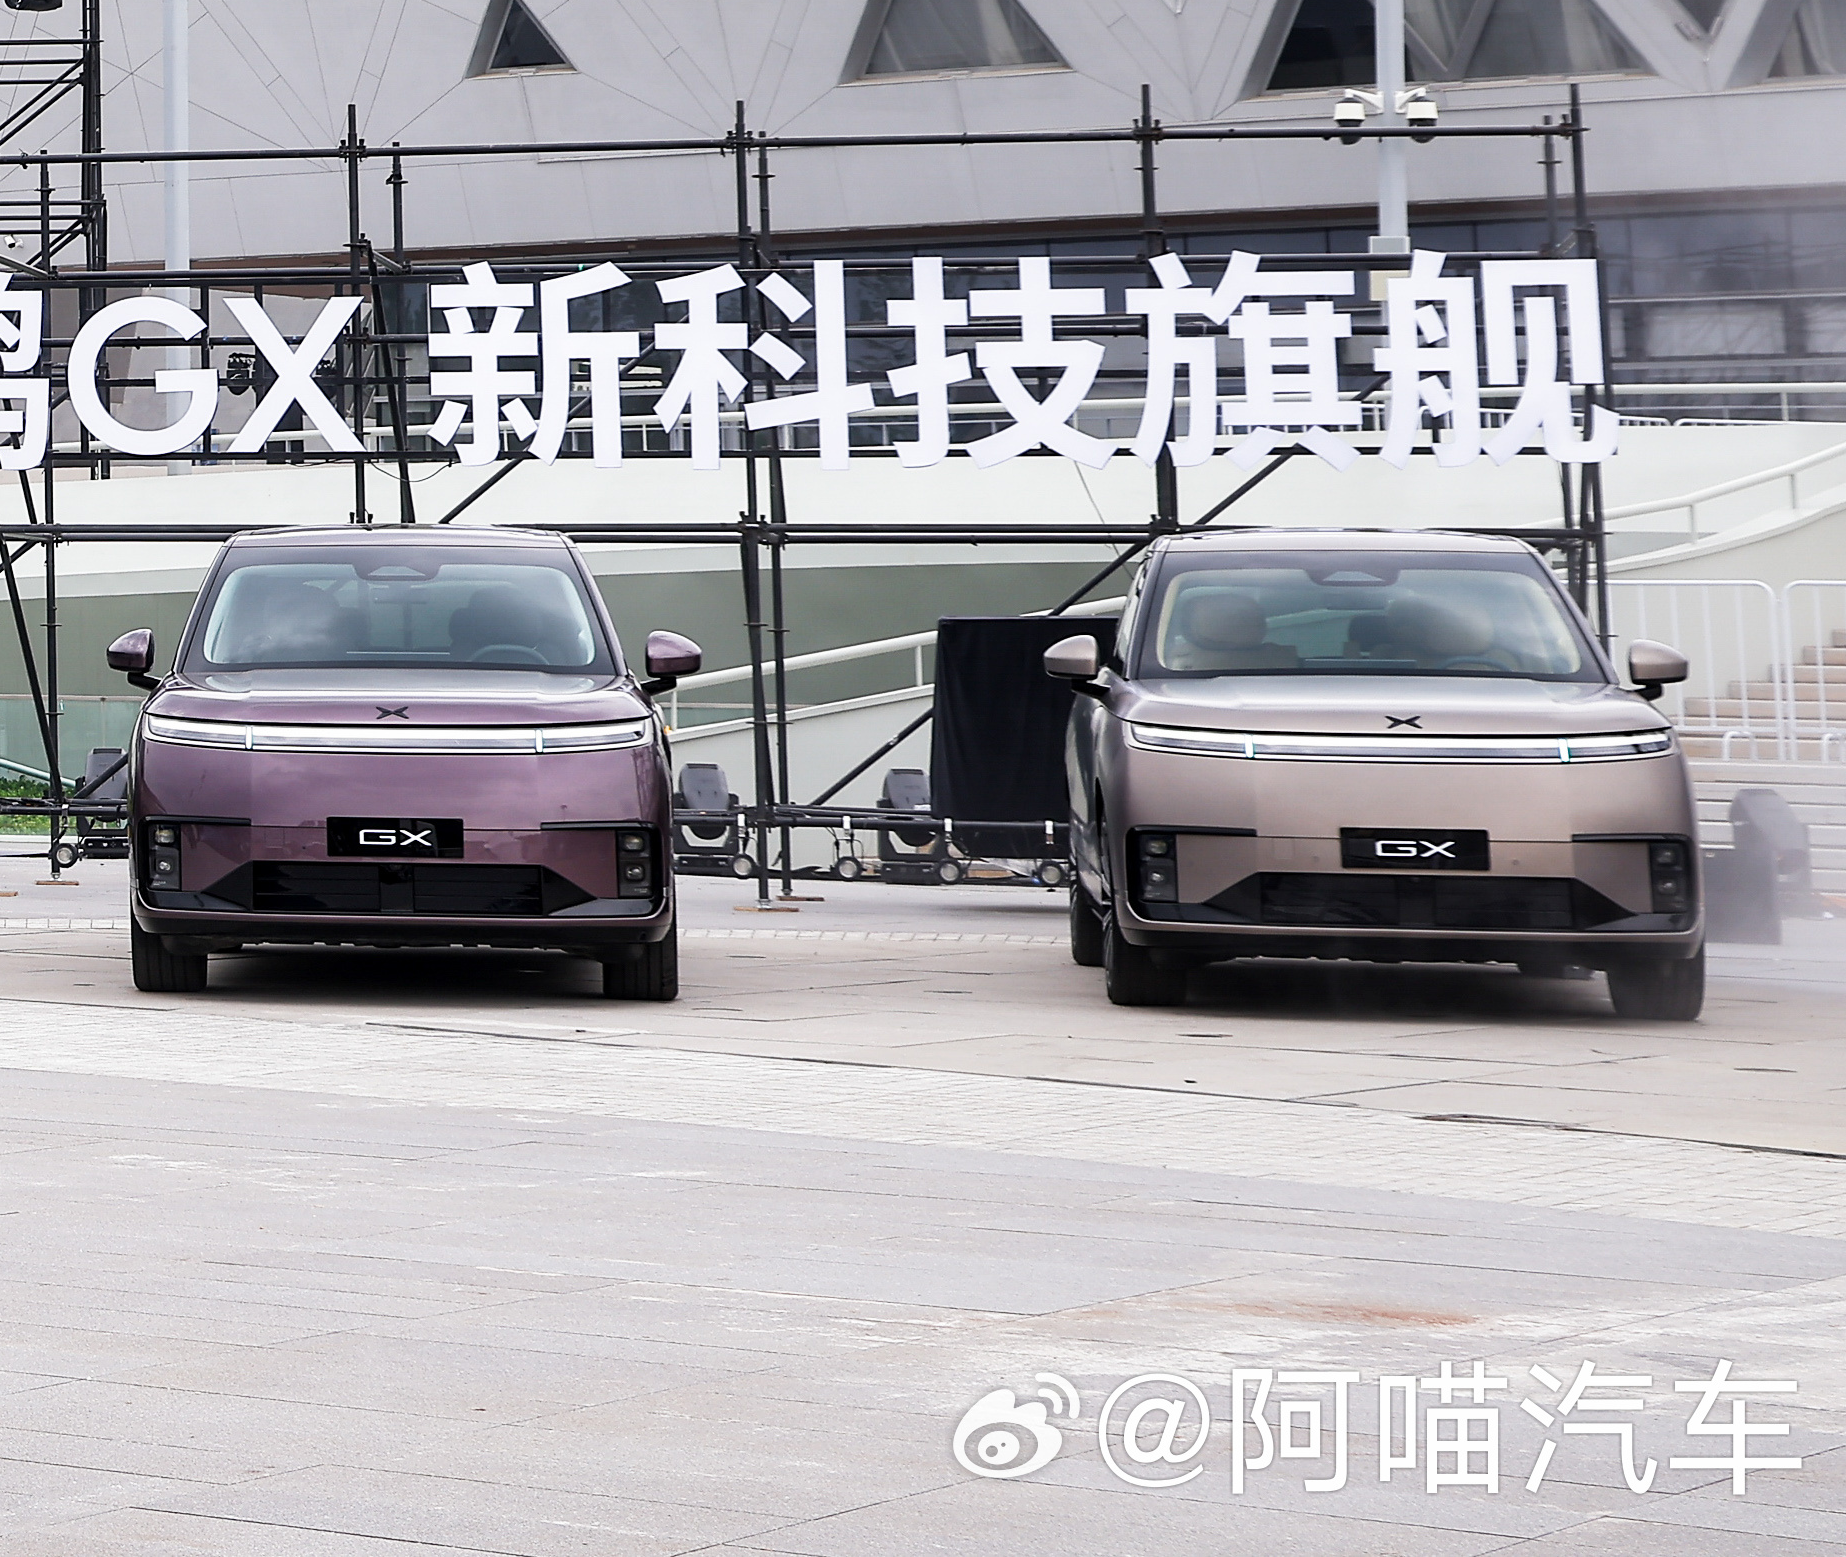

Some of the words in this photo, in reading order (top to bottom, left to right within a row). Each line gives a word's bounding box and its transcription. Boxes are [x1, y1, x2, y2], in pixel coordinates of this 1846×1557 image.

[427, 249, 1619, 471] 新科技旗舰
[359, 829, 432, 846] GX
[1375, 840, 1456, 858] GX
